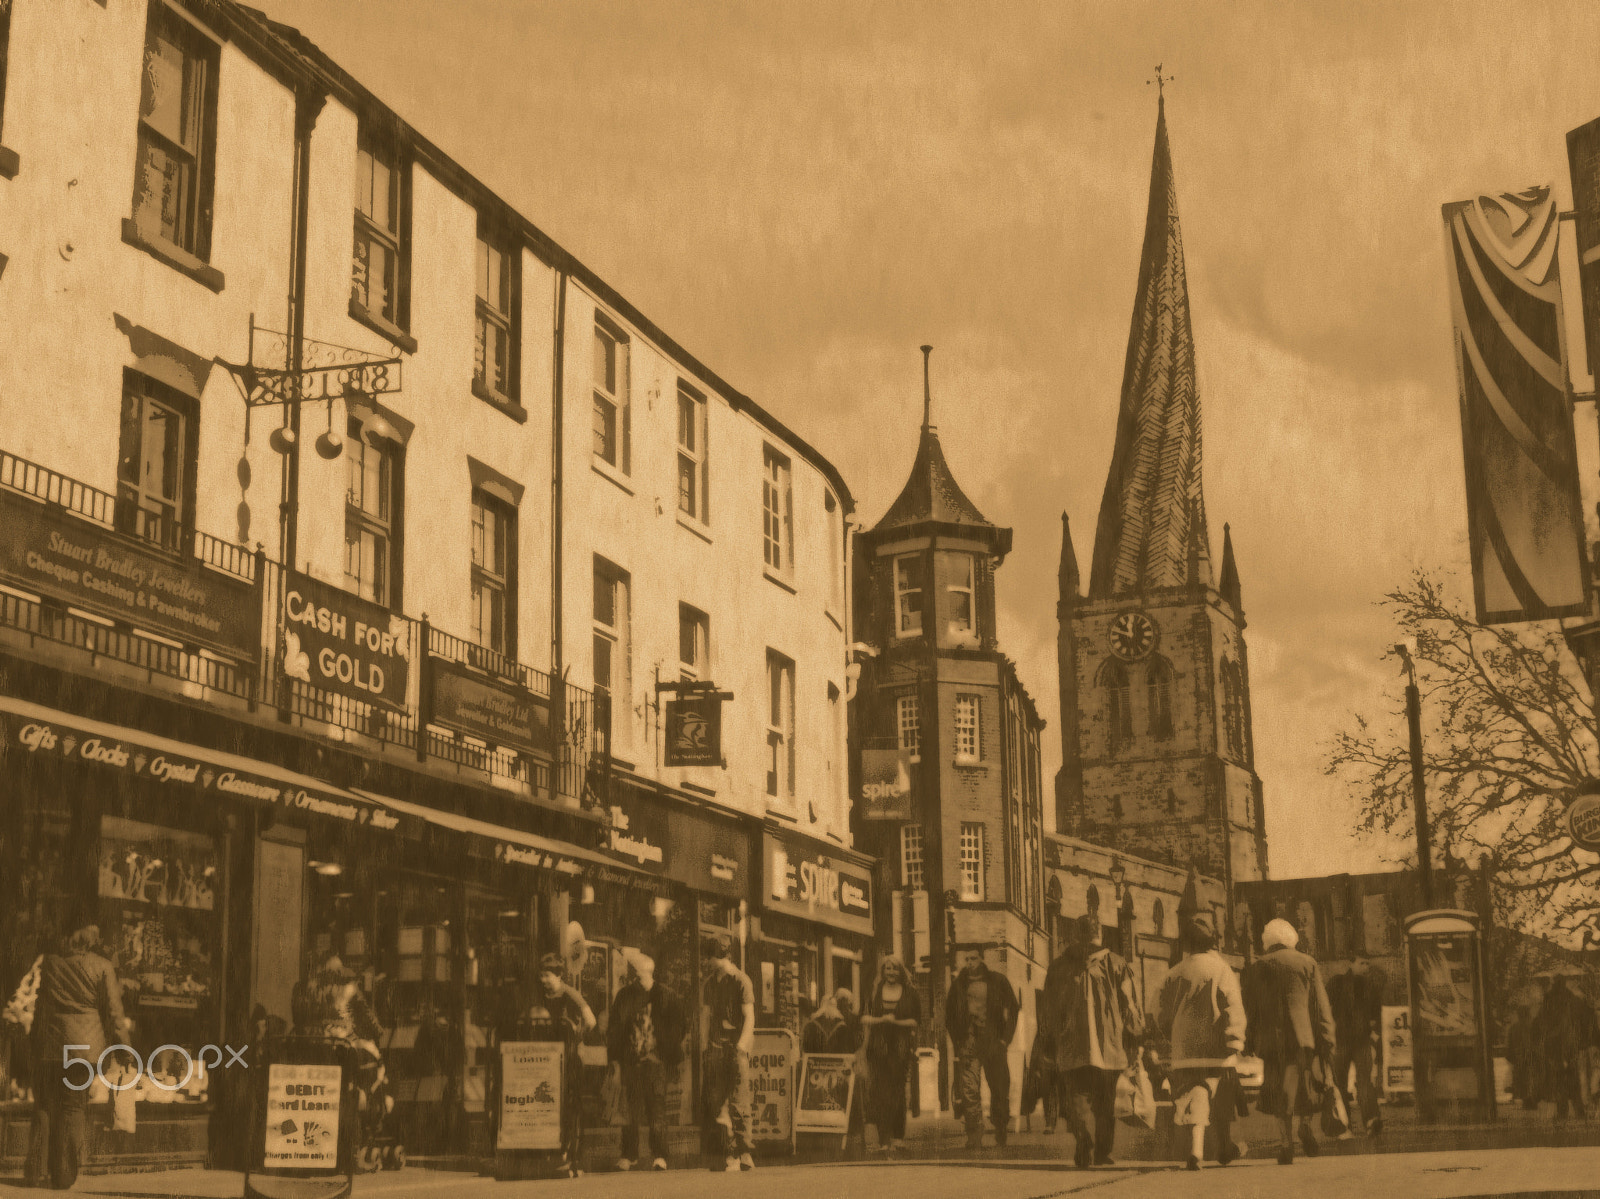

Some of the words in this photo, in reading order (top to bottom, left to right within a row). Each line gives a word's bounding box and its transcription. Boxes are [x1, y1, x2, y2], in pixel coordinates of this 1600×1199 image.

[48, 531, 93, 564] Stuart
[26, 551, 79, 584] Cheque
[82, 571, 135, 606] Cashing
[136, 590, 147, 607] &
[354, 621, 394, 657] FOR
[318, 647, 385, 694] GOLD
[19, 723, 58, 752] Gifts
[80, 738, 129, 767] Clocks
[150, 756, 200, 783] Crystal
[746, 1052, 785, 1073] heque
